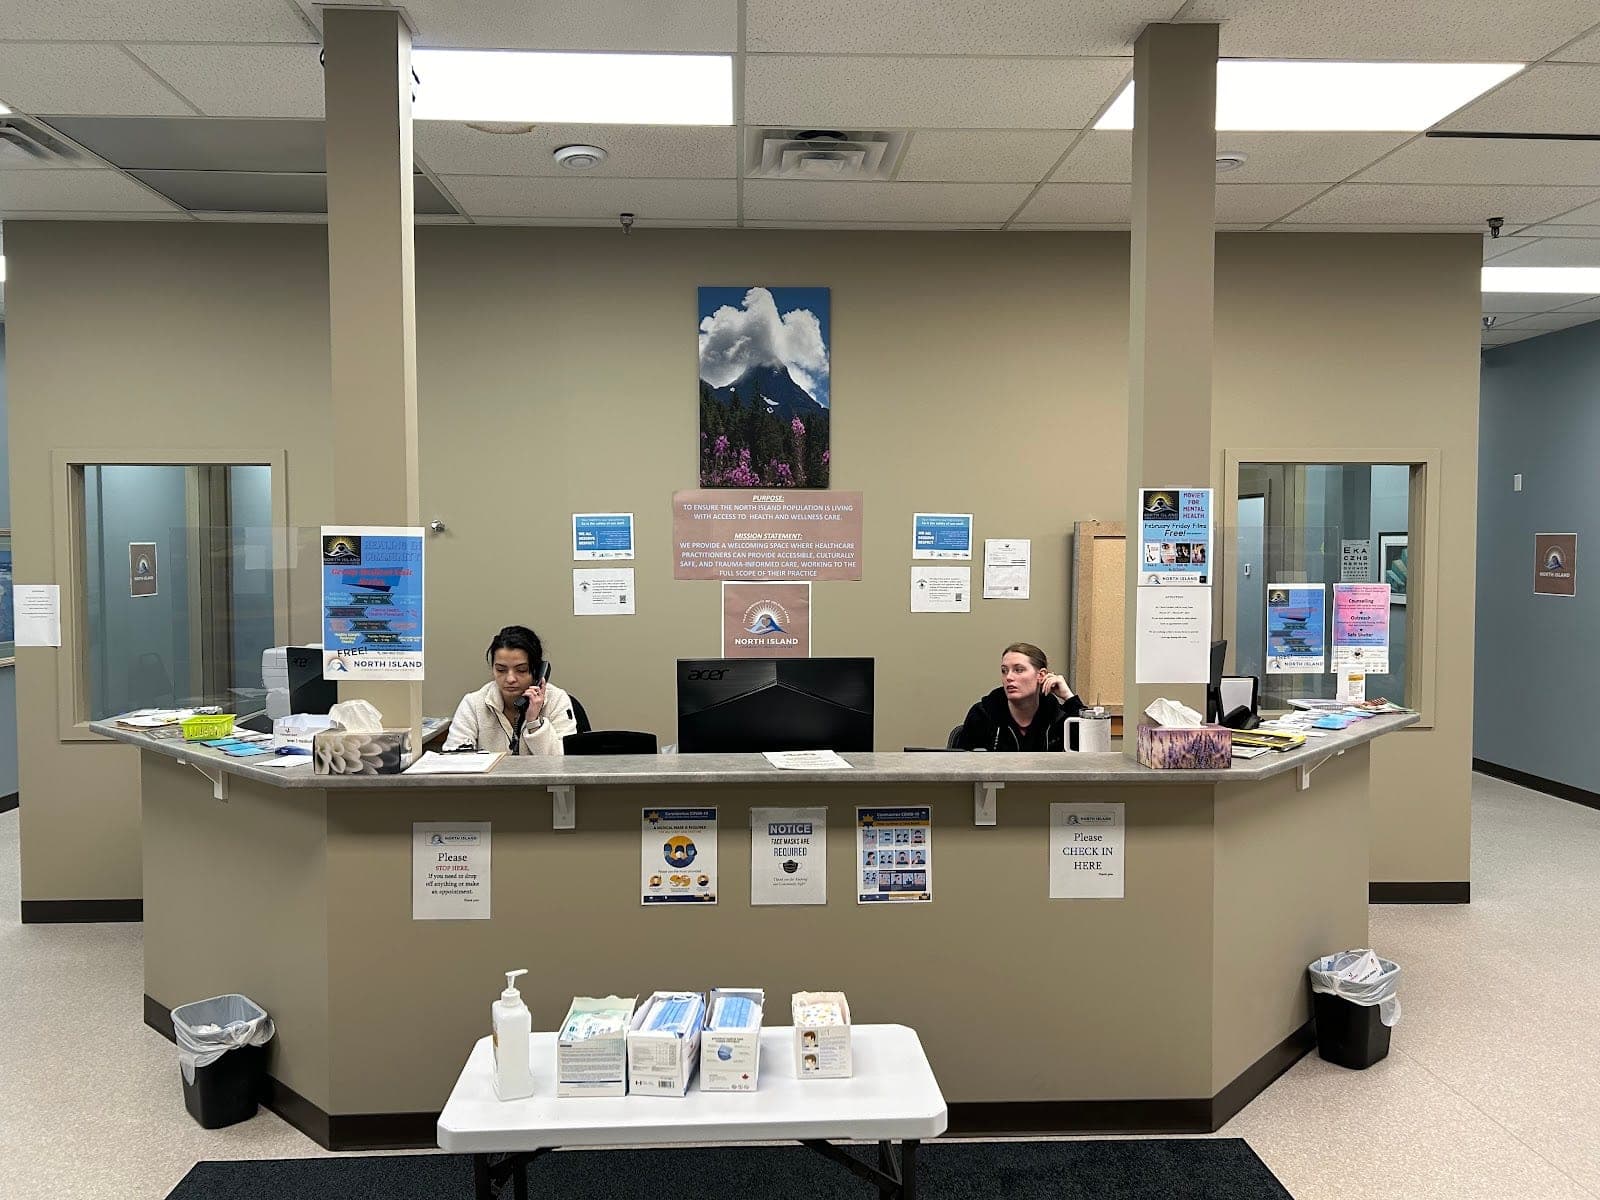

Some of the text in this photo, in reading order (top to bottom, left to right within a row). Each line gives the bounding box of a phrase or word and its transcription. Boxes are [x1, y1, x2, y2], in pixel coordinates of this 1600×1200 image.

[752, 494, 784, 502] PURPOSE:
[337, 646, 367, 657] FREE!
[688, 669, 730, 680] acer
[770, 824, 811, 833] NOTICE
[1074, 833, 1102, 841] Please
[774, 848, 807, 856] REQUIRED
[438, 852, 467, 862] Please
